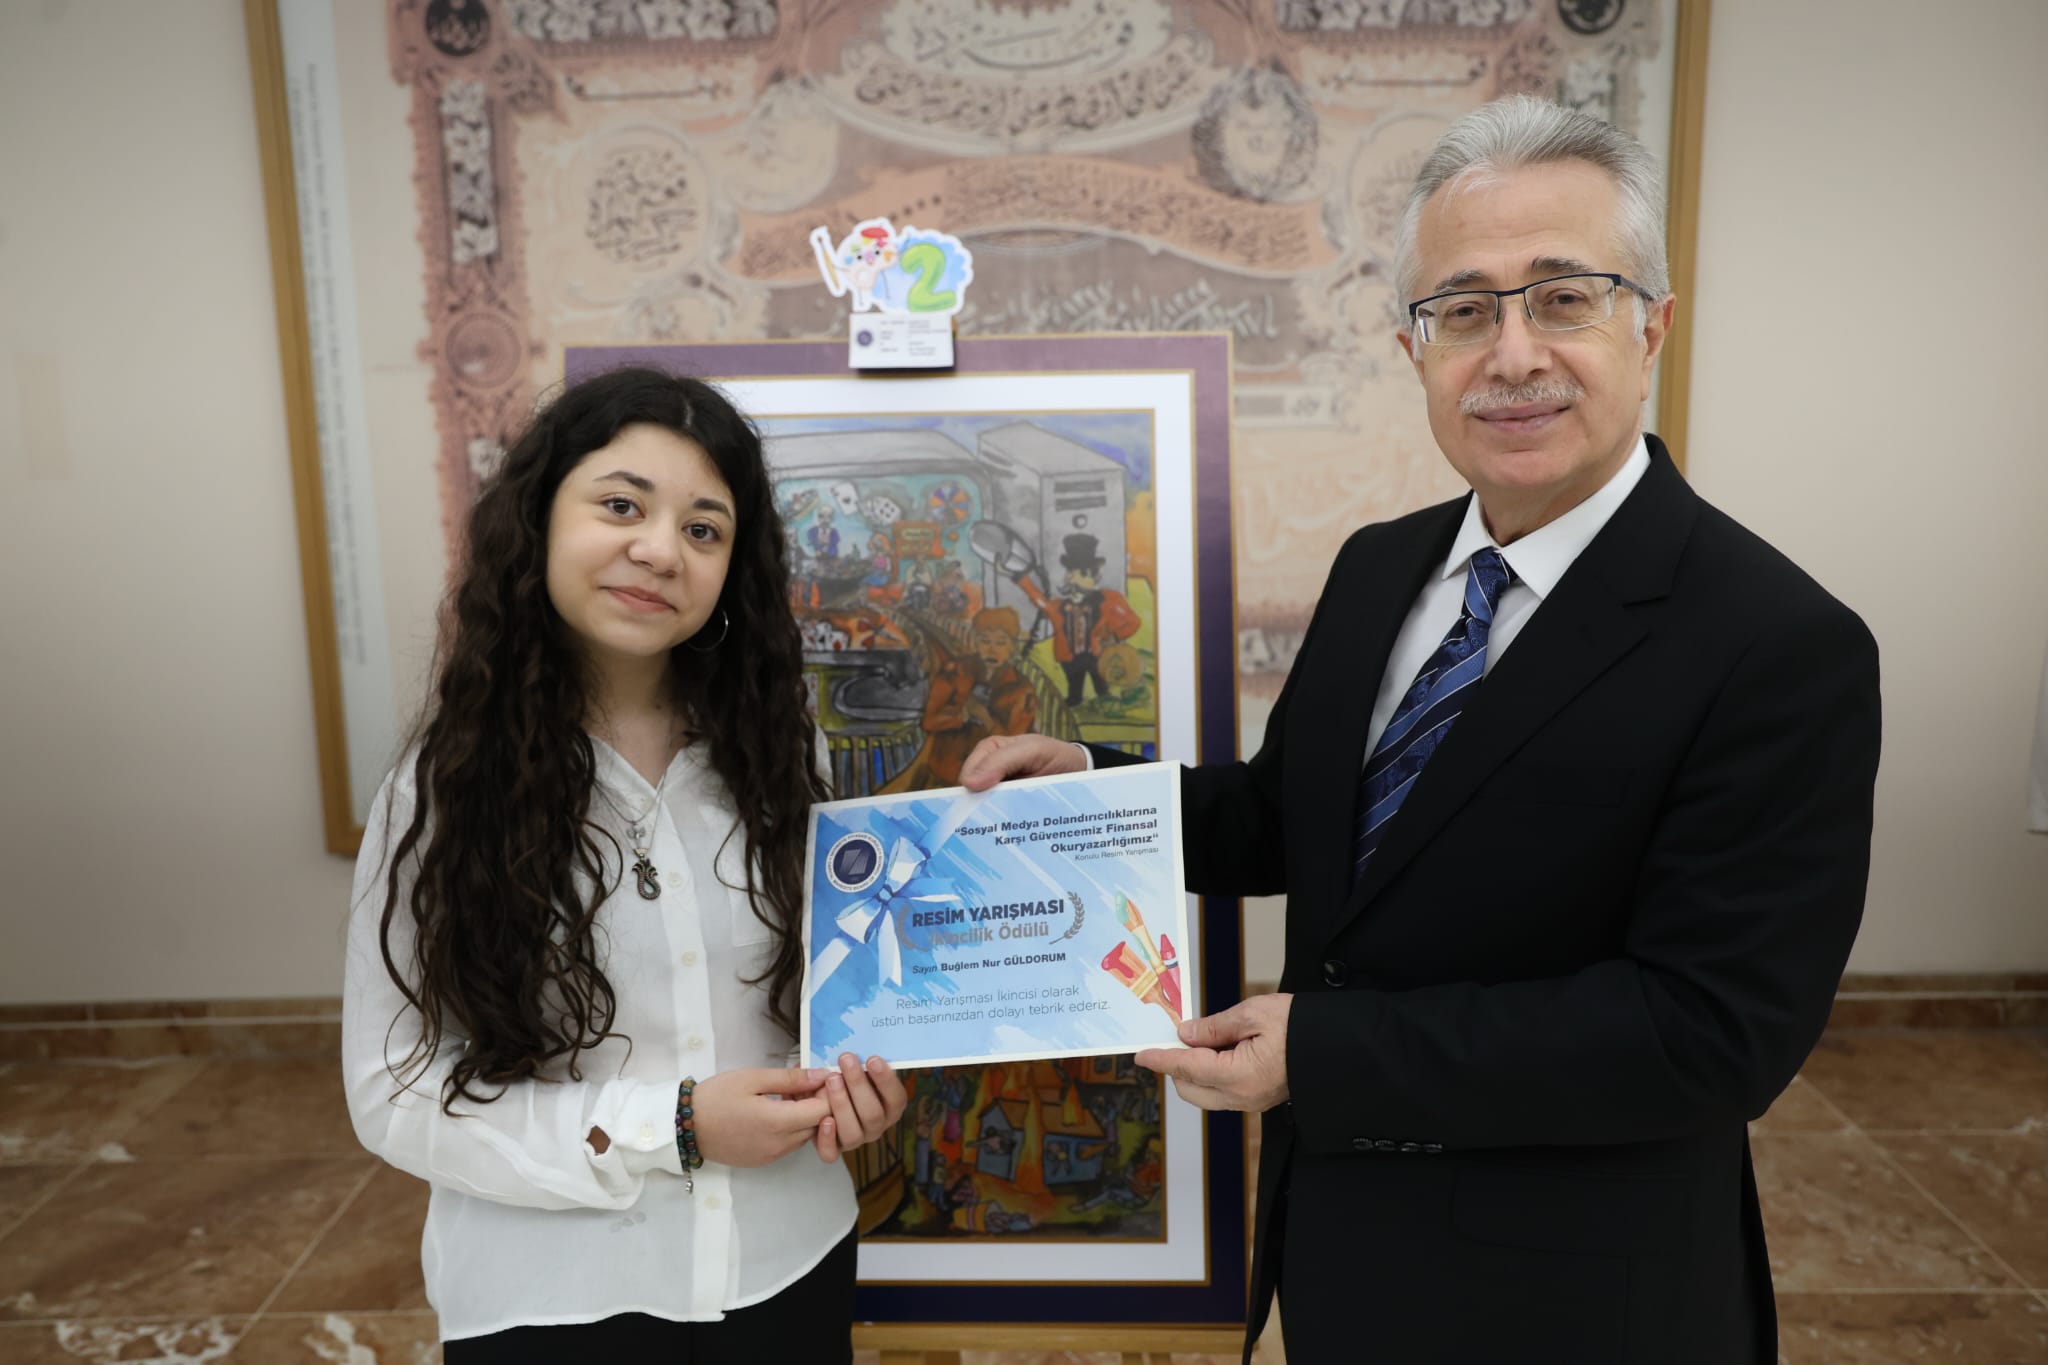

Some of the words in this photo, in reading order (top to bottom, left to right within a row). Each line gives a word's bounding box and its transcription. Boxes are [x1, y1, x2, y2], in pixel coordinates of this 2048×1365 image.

[900, 242, 957, 312] 2
[1002, 820, 1040, 832] Medya
[1044, 807, 1157, 826] Dolandırıcılıklarına
[995, 834, 1026, 846] Karşı
[1030, 826, 1102, 842] Güvencemiz
[1106, 819, 1158, 834] Finansal
[1074, 853, 1100, 862] Konulu
[1101, 850, 1124, 859] Resim
[912, 906, 964, 928] RESİM
[969, 899, 1064, 922] YARIŞMASI
[998, 922, 1049, 940] Ödülü
[912, 965, 938, 975] Sayın
[941, 961, 980, 972] Buğlem
[982, 959, 1000, 968] Nur
[1004, 952, 1066, 966] GÜLDORUM
[896, 998, 932, 1010] Resim
[936, 994, 993, 1008] Yarışması
[998, 988, 1037, 1001] İkincisi
[1041, 985, 1080, 998] olarak
[871, 1015, 904, 1028] üstün
[908, 1008, 984, 1025] başarınızdan
[988, 1005, 1025, 1020] dolayı
[1029, 1002, 1064, 1015] tebrik
